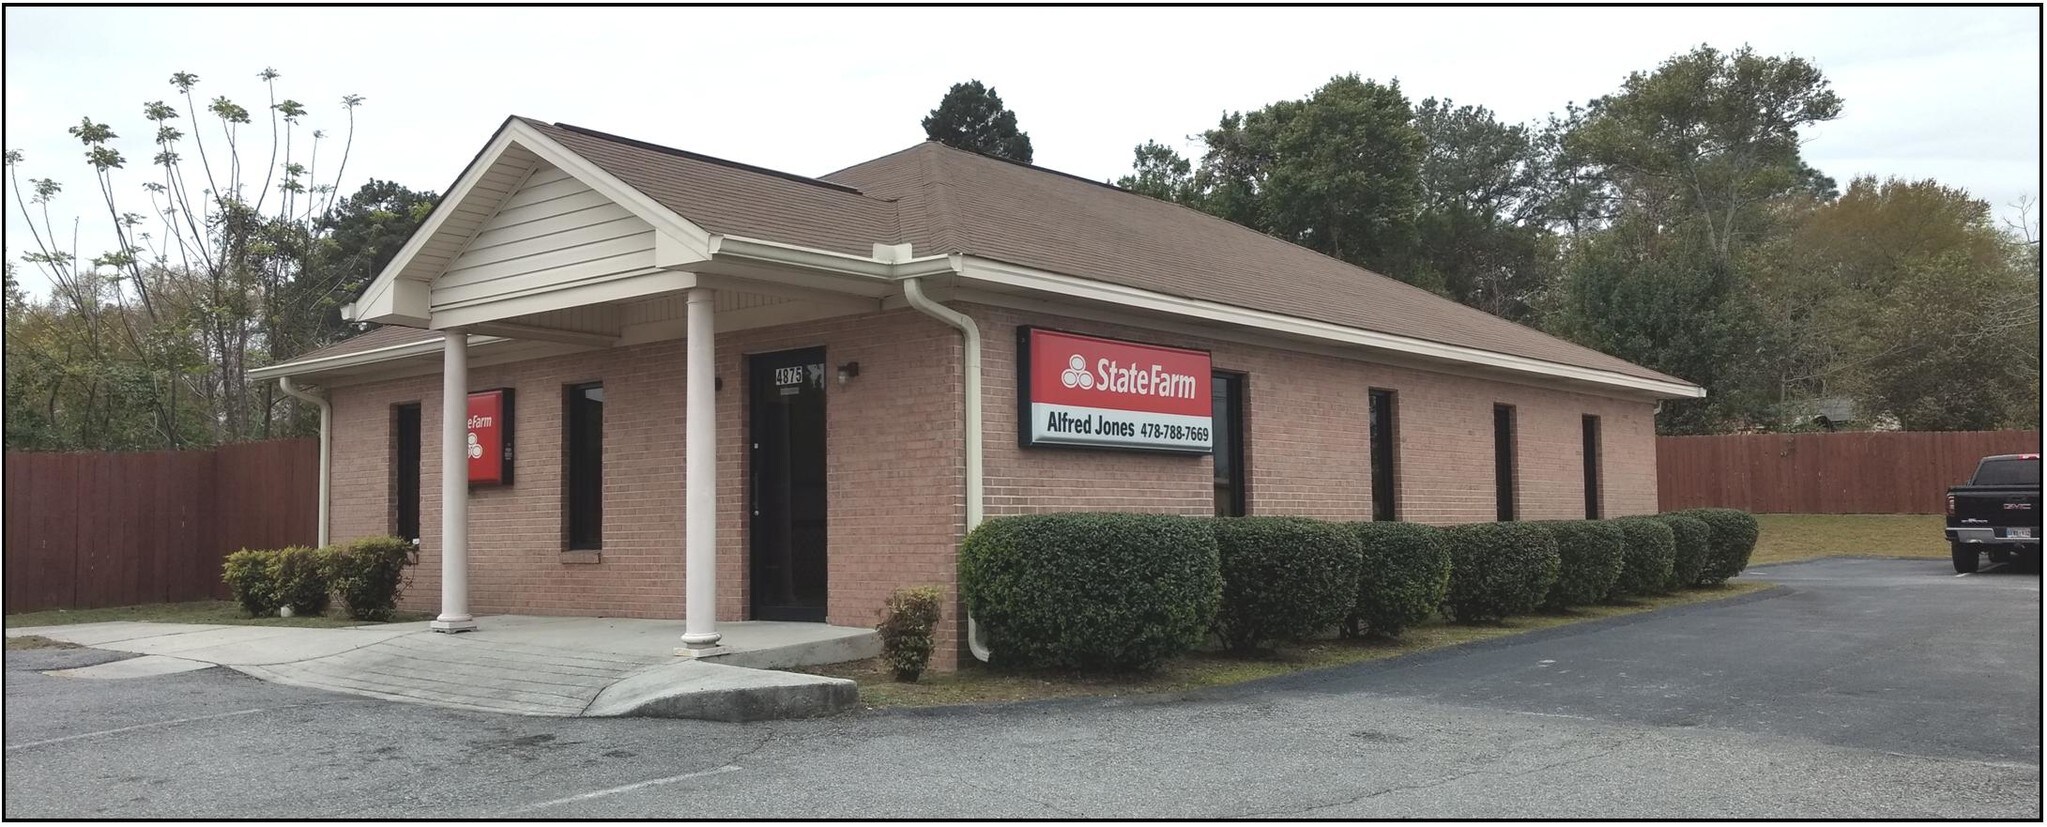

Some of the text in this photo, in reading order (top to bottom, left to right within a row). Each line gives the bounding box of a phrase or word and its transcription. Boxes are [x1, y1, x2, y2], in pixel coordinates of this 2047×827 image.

[776, 367, 802, 385] 4875
[1047, 411, 1209, 442] Alfred Jones 478-788-7669
